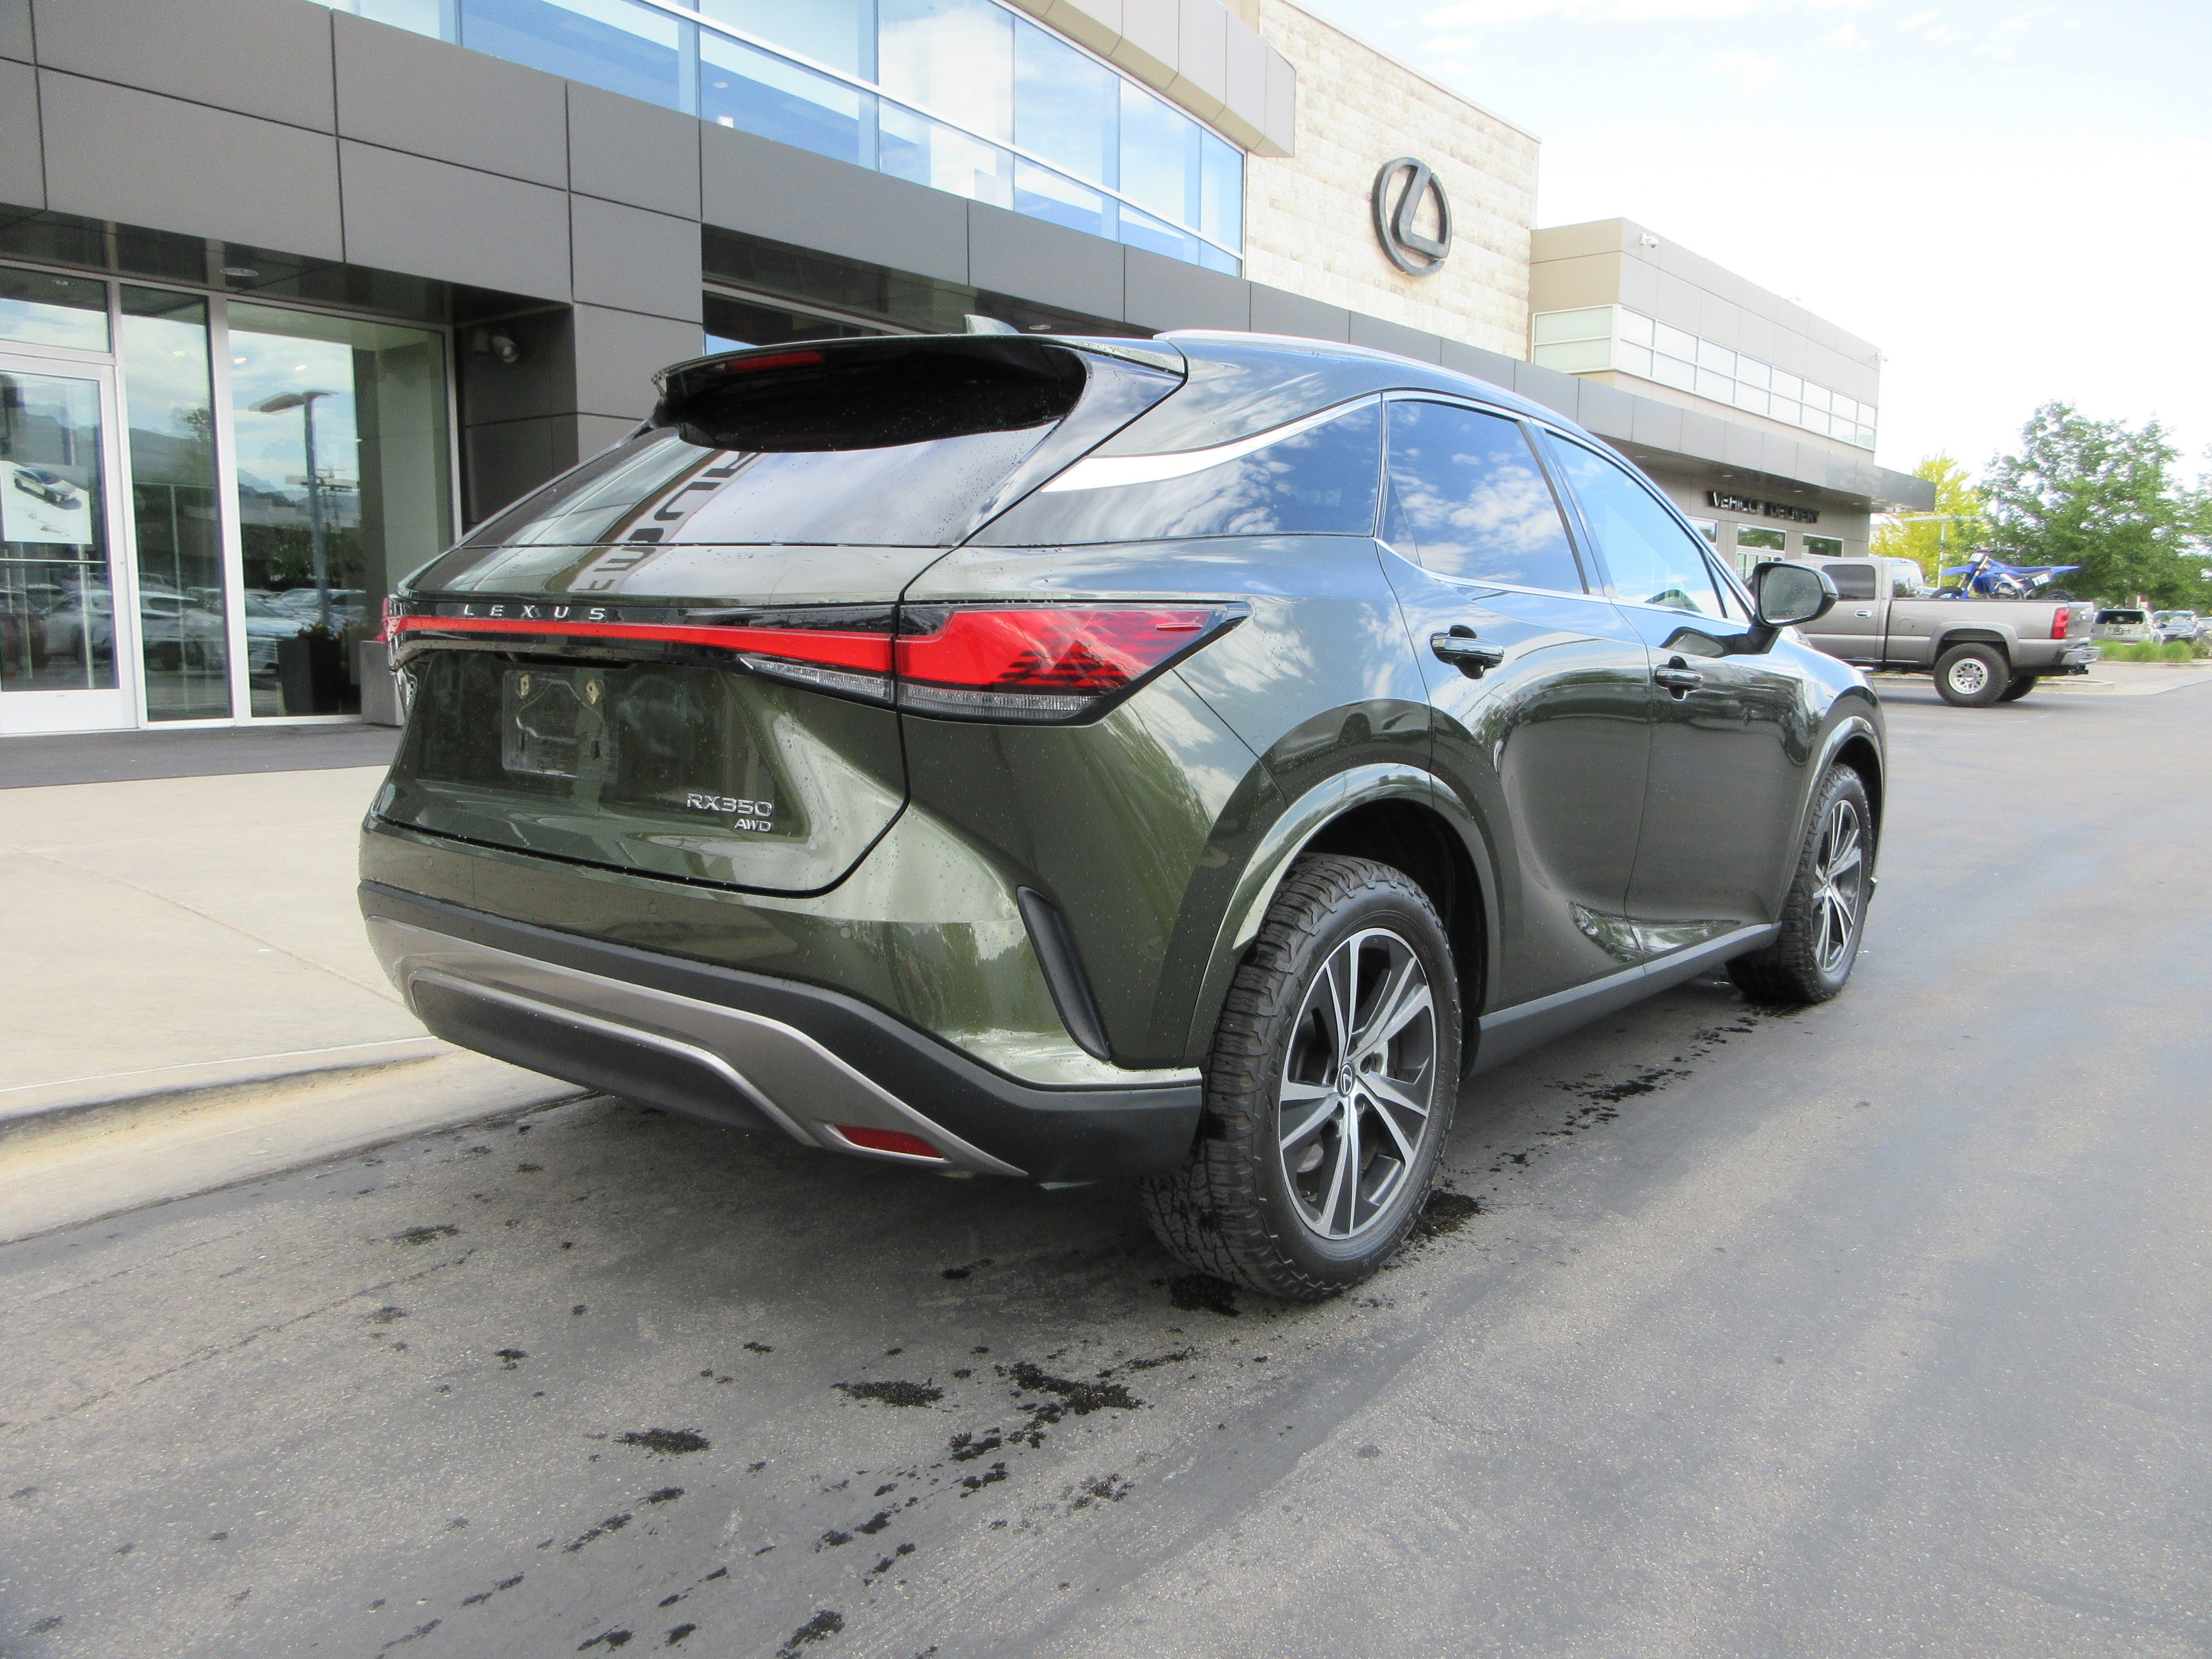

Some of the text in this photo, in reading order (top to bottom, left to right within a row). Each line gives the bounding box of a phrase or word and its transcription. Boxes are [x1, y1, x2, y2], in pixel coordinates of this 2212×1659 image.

[463, 604, 605, 620] LEXUS
[687, 793, 773, 817] RX350
[734, 818, 772, 832] AWD
